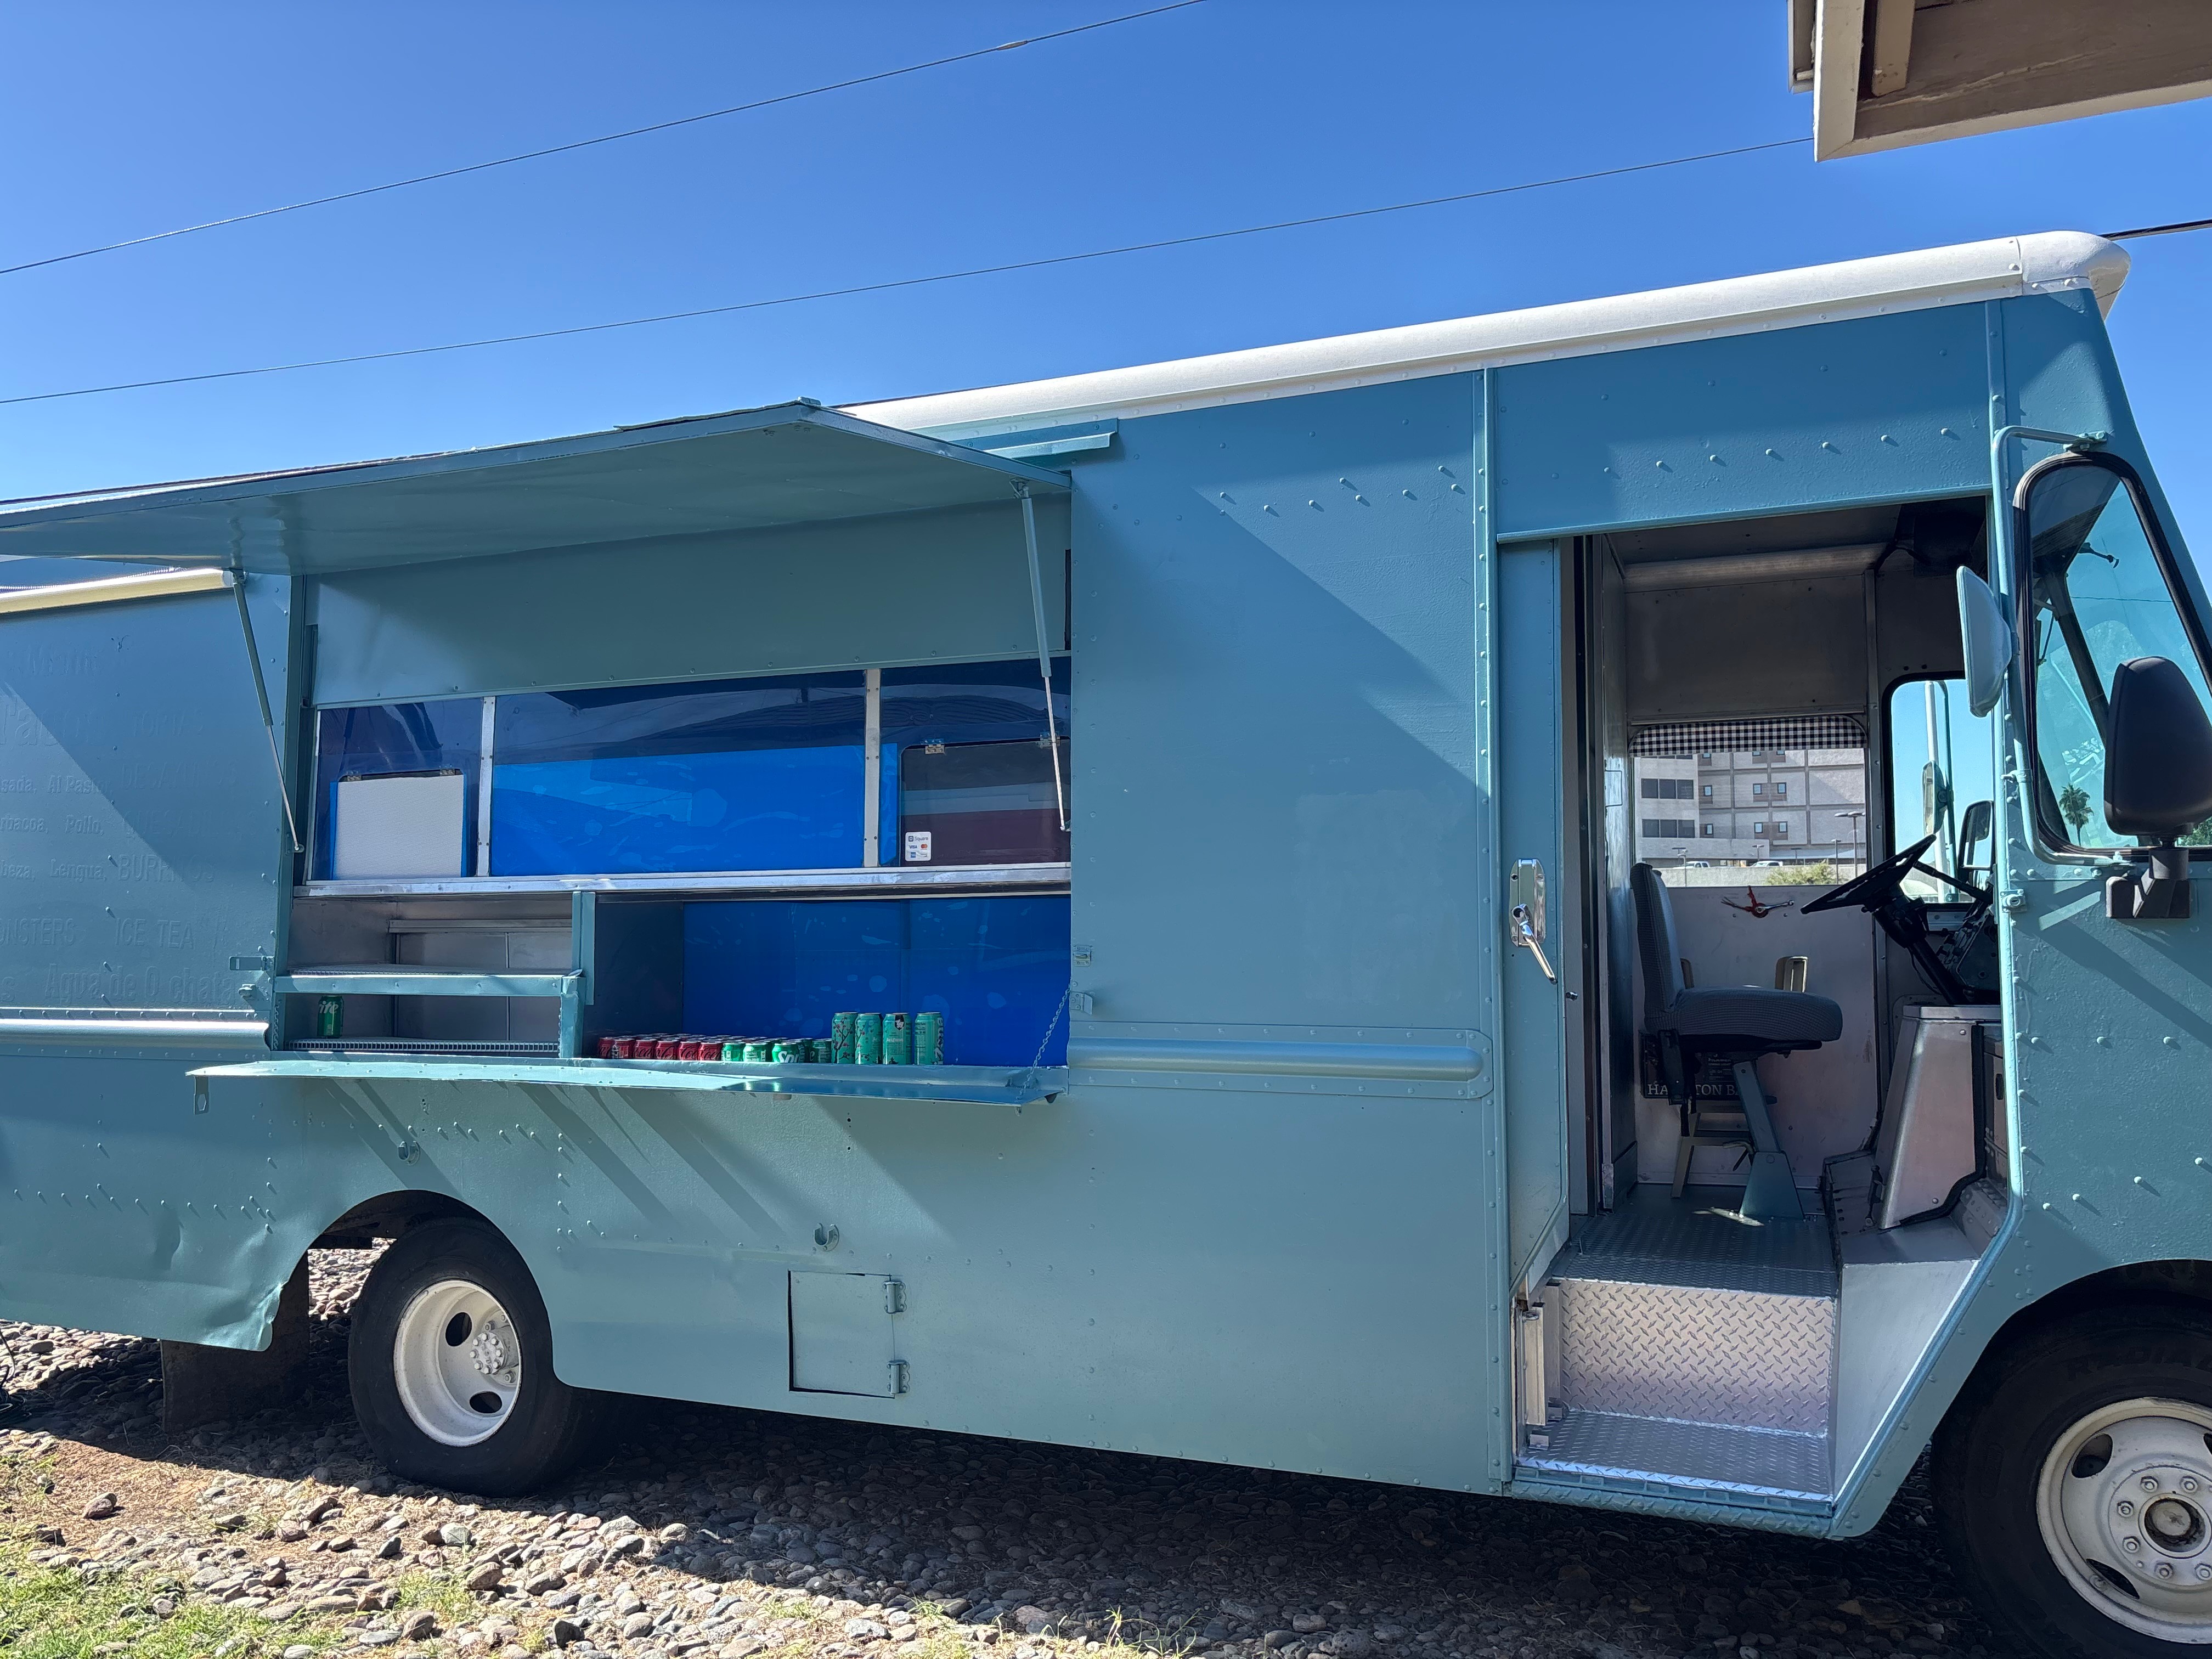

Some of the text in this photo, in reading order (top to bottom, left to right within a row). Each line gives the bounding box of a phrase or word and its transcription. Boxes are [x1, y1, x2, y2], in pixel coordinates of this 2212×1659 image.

[47, 775, 62, 794] Al
[49, 859, 108, 883] Lengua,
[115, 917, 146, 947] ICE
[157, 919, 195, 950] TEA
[319, 1000, 339, 1014] ite
[1647, 1083, 1722, 1096] HATON
